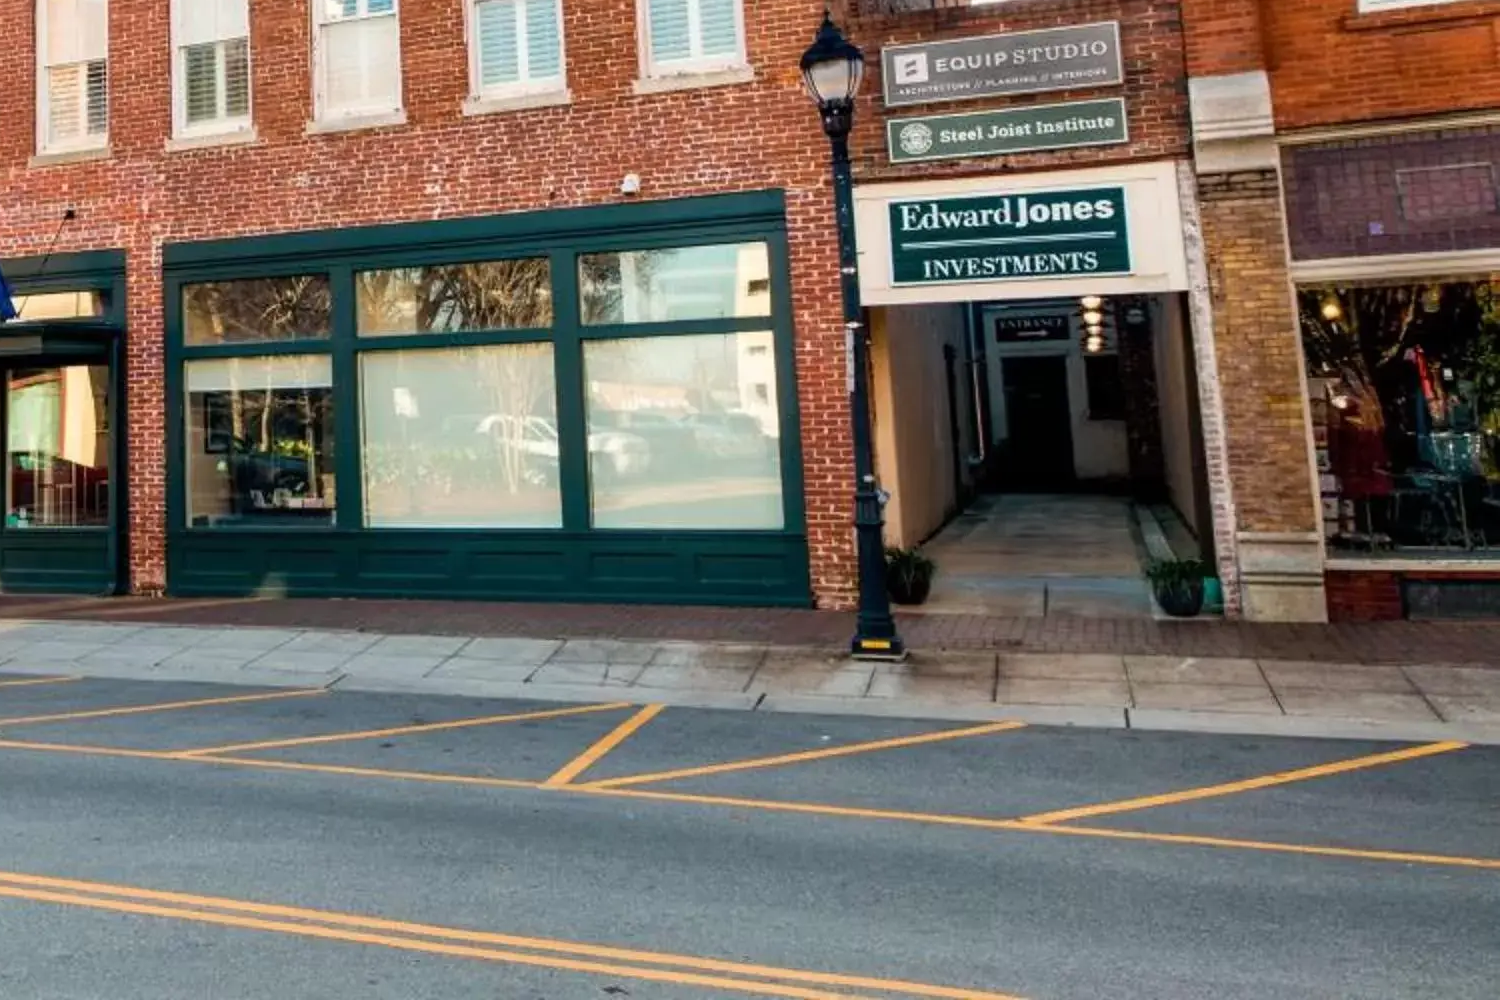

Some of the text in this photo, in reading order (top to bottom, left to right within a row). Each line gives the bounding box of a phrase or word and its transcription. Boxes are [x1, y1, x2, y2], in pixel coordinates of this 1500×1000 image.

[935, 40, 1108, 73] EQUIP STUDIO
[939, 115, 1115, 143] Steel Joist Institute
[900, 197, 1116, 231] Edward Jones
[924, 251, 1100, 279] INVESTMENTS
